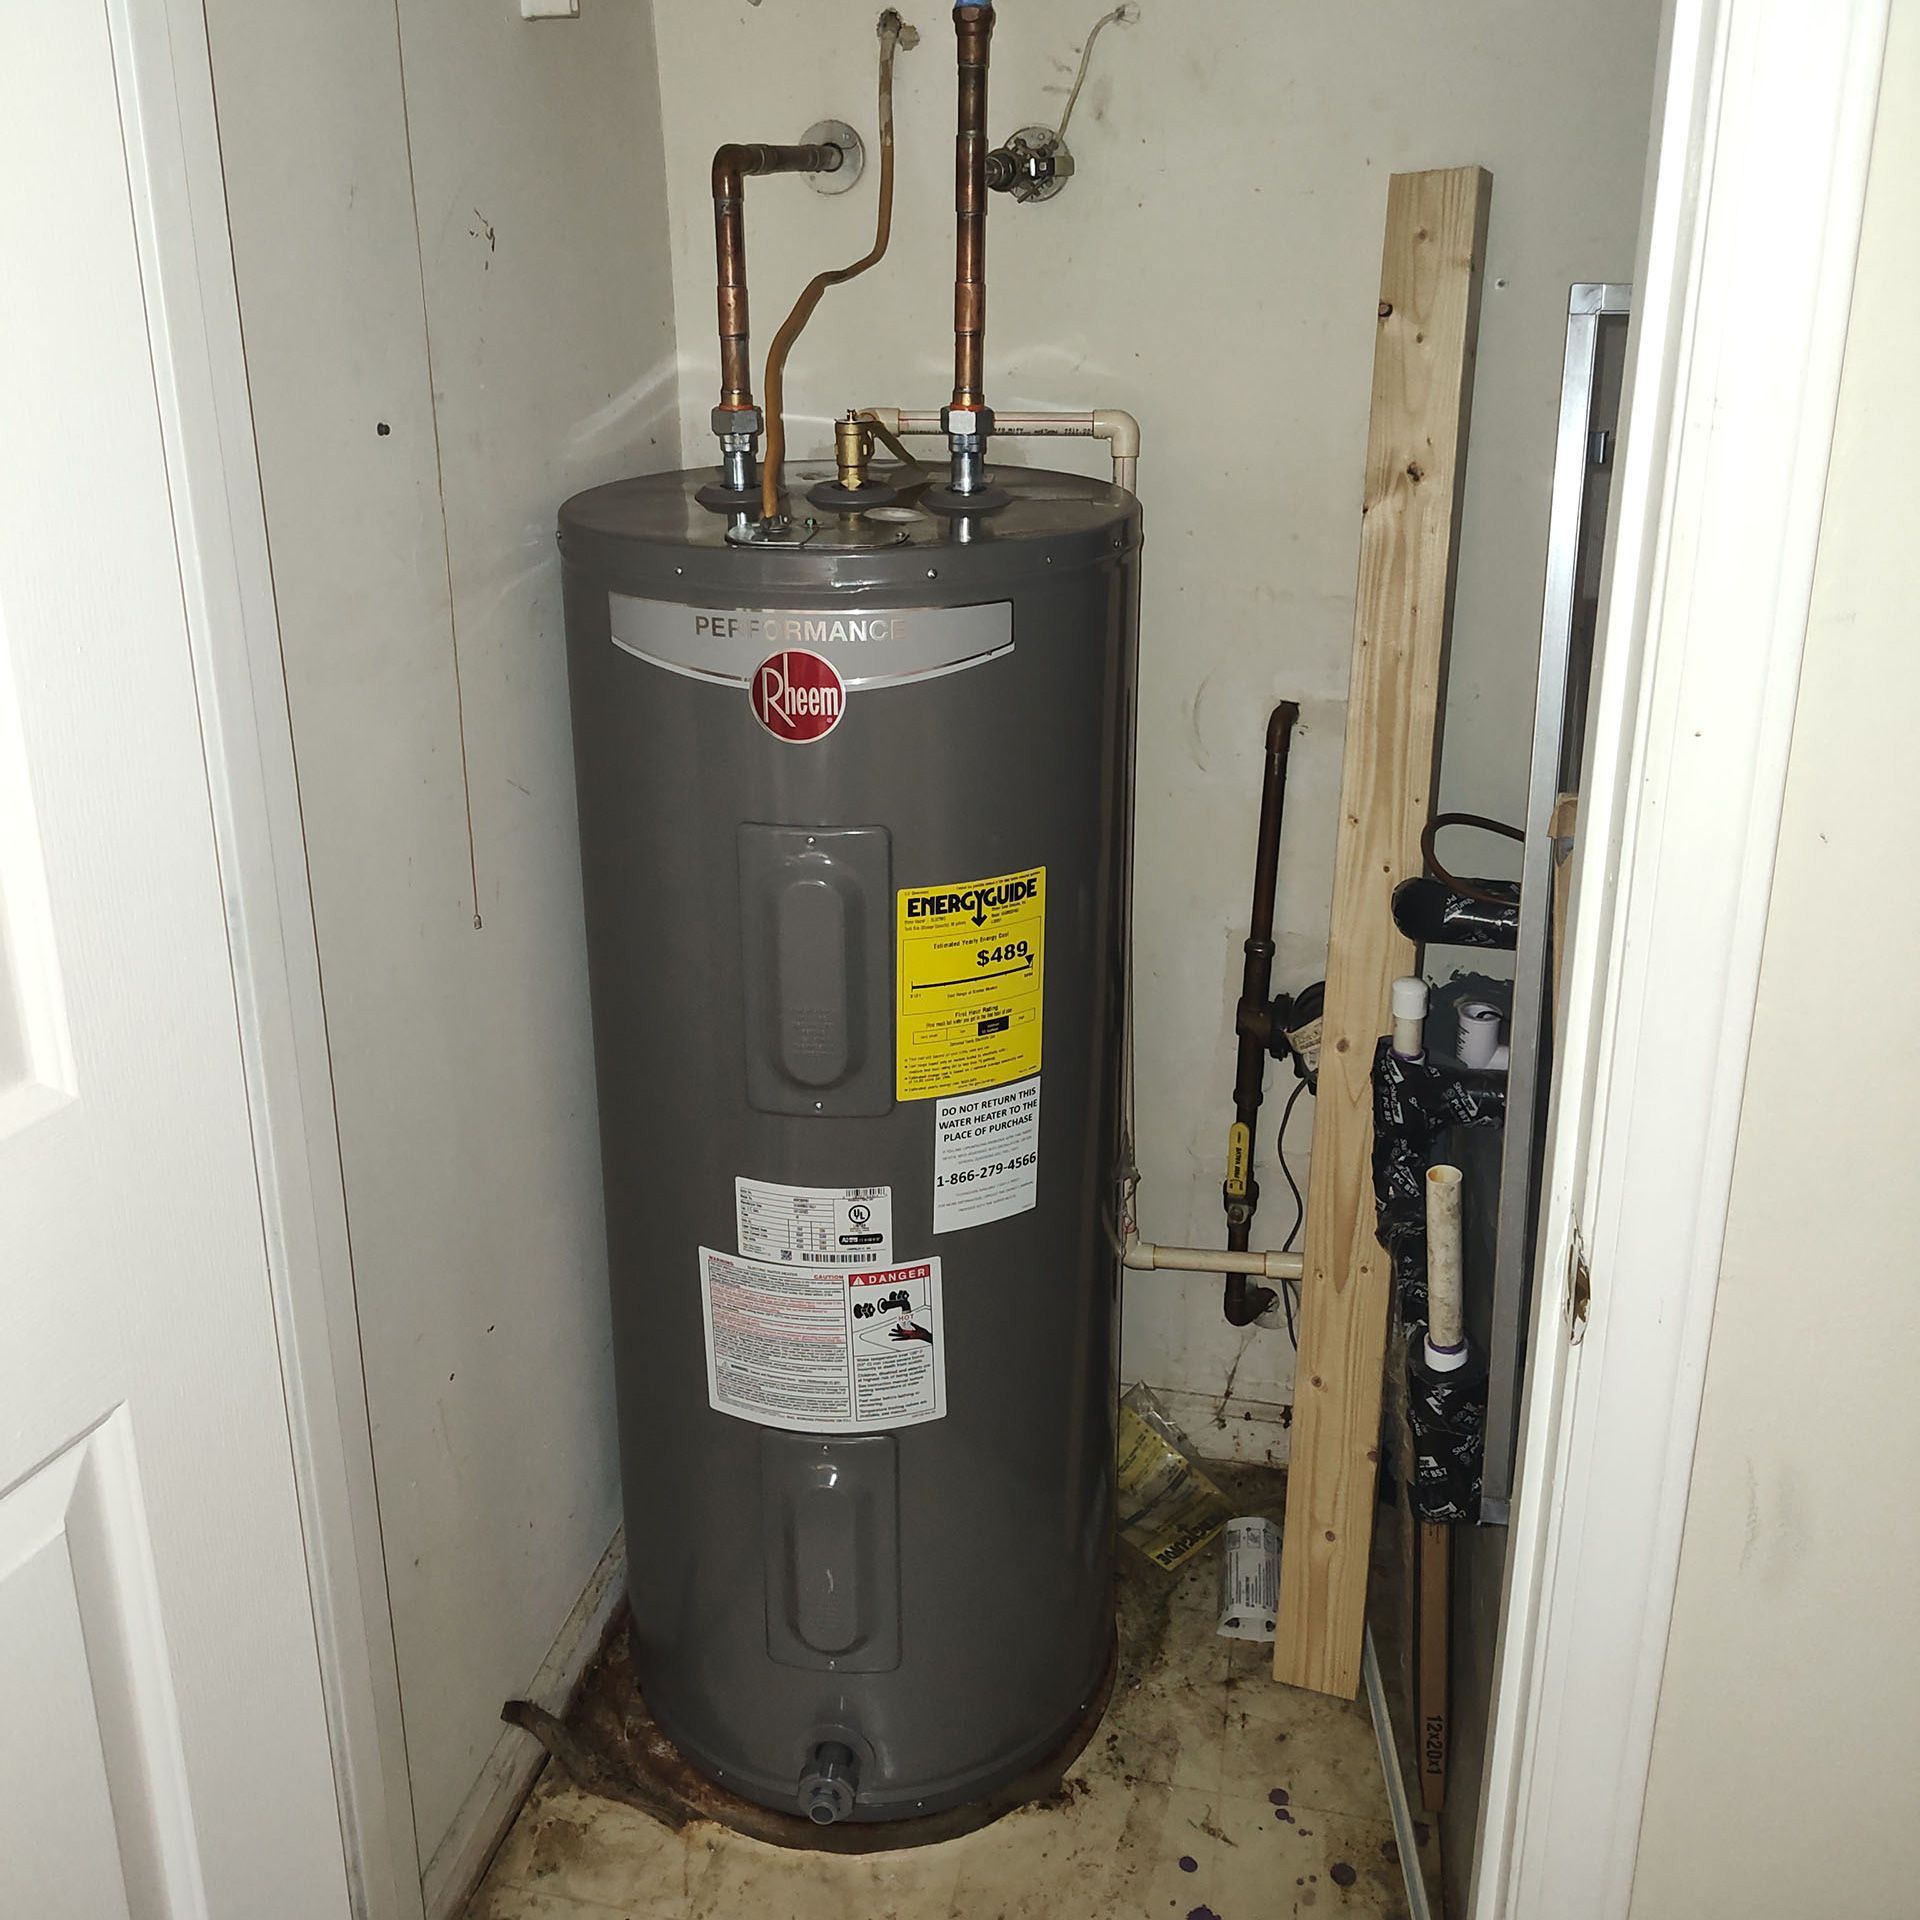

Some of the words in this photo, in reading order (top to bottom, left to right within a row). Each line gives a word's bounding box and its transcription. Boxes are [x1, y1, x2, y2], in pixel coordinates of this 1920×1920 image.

[695, 615, 906, 642] PERFORMANCE
[761, 653, 839, 727] Rheem
[907, 877, 1038, 917] ENERGYGUIDE
[976, 940, 1029, 967] $489
[939, 1118, 972, 1130] WATER
[974, 1109, 1007, 1124] HEATER
[1009, 1104, 1021, 1114] TO
[1023, 1098, 1038, 1111] THE
[942, 1106, 957, 1117] DO
[959, 1102, 980, 1114] NOT
[981, 1094, 1018, 1109] RETURN
[1019, 1087, 1037, 1100] THIS
[1450, 1098, 1461, 1111] PC
[943, 1130, 972, 1142] PLACE
[974, 1126, 987, 1137] OF
[989, 1113, 1033, 1133] PURCHASE
[936, 1151, 1037, 1187] 1-866-279-4566
[1393, 1172, 1405, 1185] PC
[868, 1267, 926, 1285] DANGER
[898, 1313, 915, 1322] HOT
[1430, 1467, 1448, 1478] 857
[1426, 1715, 1444, 1776] 12x20x1
